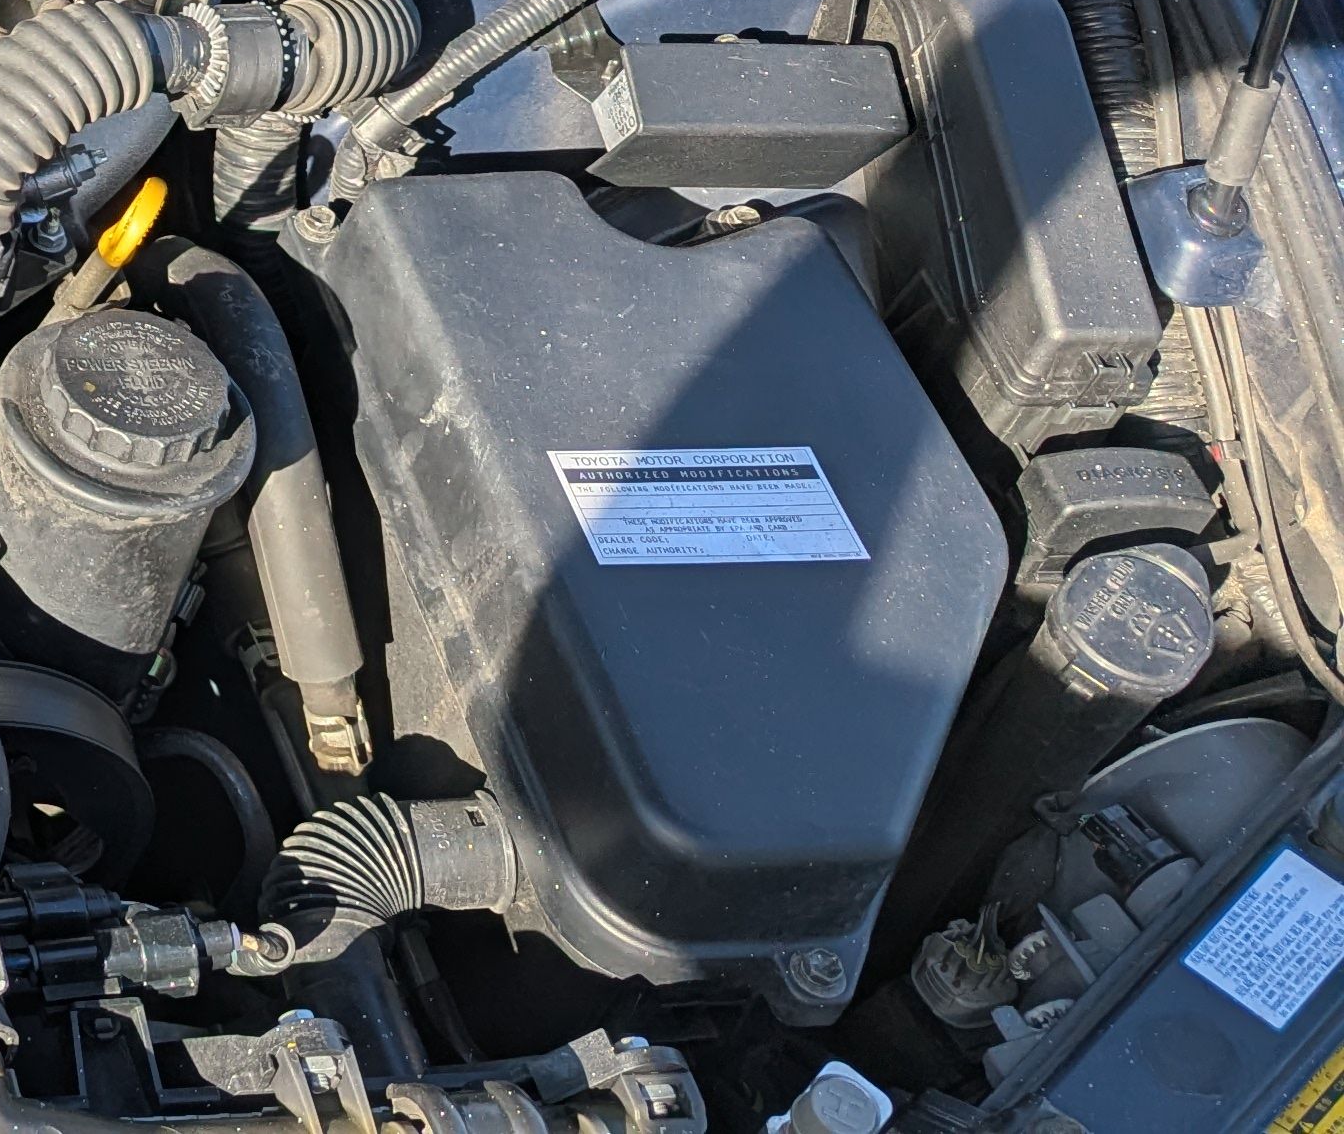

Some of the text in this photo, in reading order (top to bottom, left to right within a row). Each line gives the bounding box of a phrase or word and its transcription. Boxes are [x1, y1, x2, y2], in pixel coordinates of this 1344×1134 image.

[63, 357, 127, 372] POWER
[571, 452, 796, 467] TOYOTA MOTOR CORPORATION
[578, 468, 800, 481] AUTHORIZED MODIFICATIONS
[576, 486, 595, 494] THE
[599, 484, 650, 494] FOLLOWING
[653, 483, 725, 493] MODIFICATIONS
[728, 483, 754, 492] HAVE
[757, 483, 781, 492] BEEN
[598, 536, 635, 545] DEALER
[640, 535, 670, 545] CODE:
[603, 546, 705, 555] CHANGE AUTHORITY:
[1074, 588, 1112, 632] WASHER
